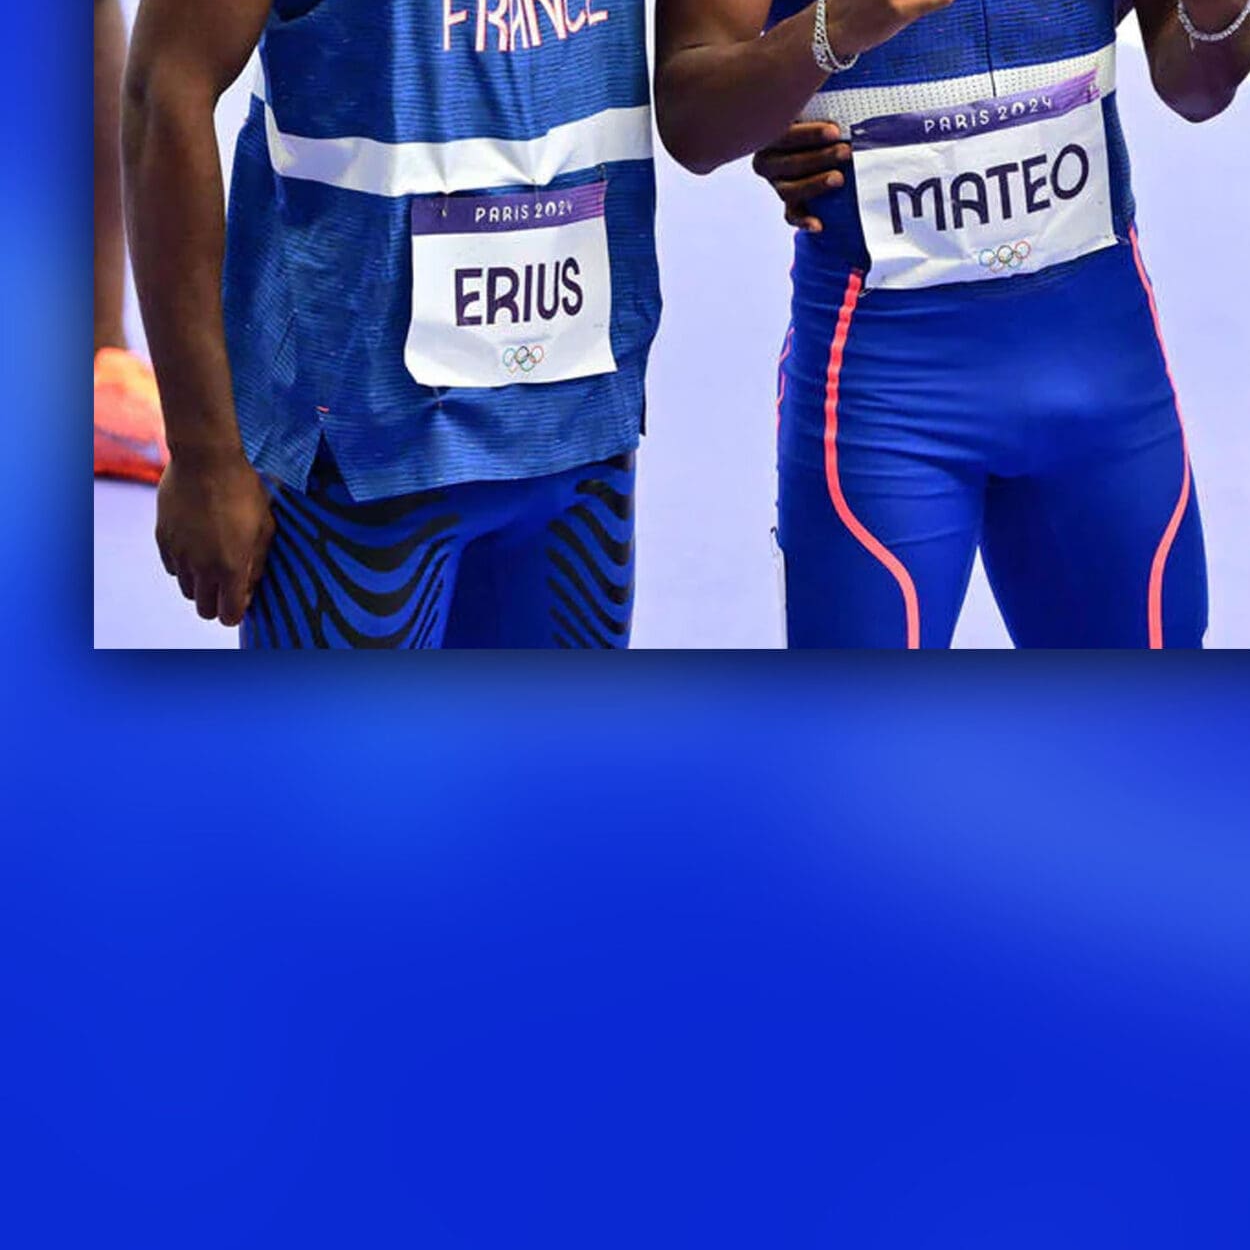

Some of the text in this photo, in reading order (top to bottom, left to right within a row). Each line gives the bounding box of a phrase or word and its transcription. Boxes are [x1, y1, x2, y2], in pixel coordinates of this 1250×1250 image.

[924, 95, 1052, 134] PARIS 2024
[474, 199, 573, 223] PARIS 2024
[886, 144, 1090, 234] MATEO
[454, 257, 584, 327] ERIUS
